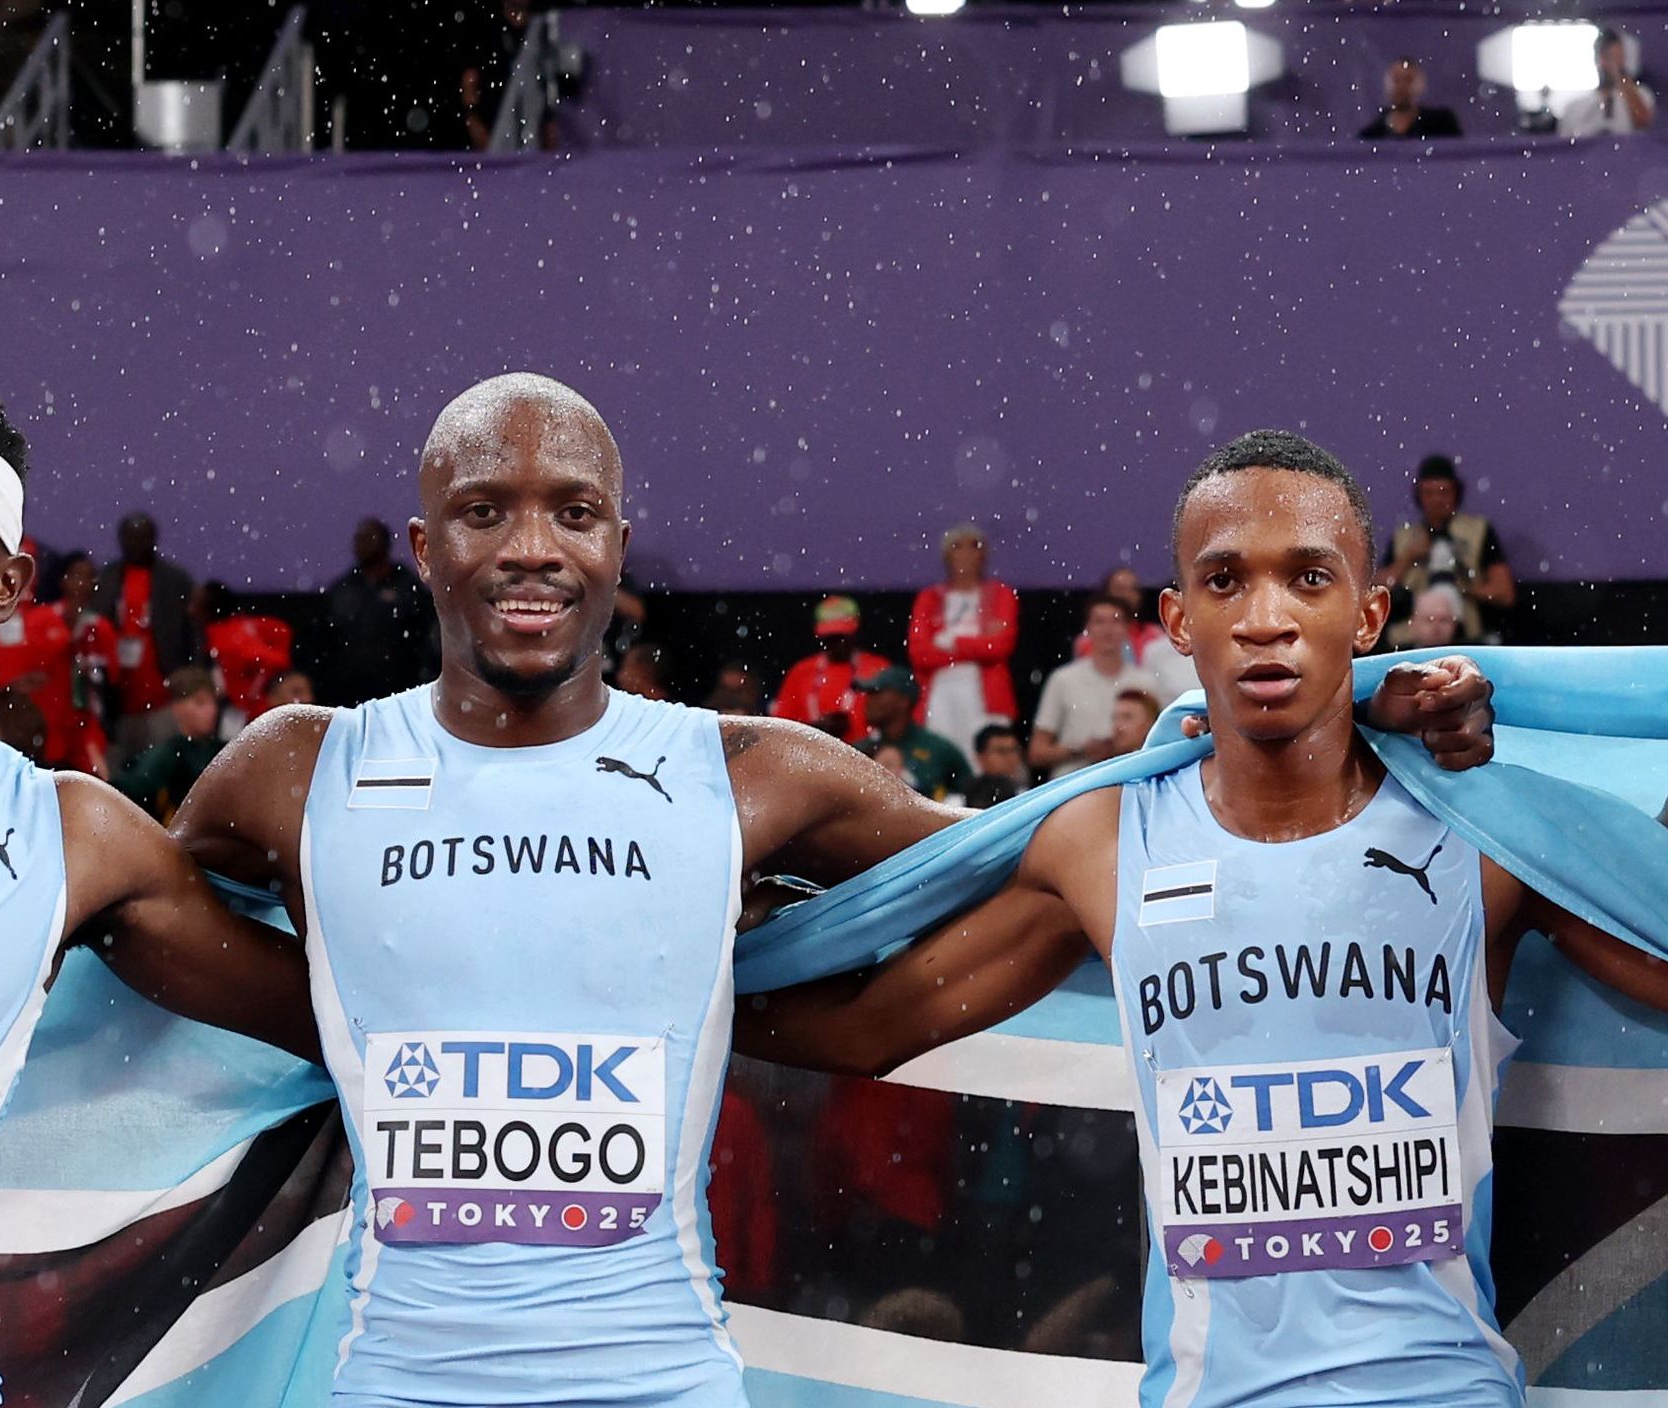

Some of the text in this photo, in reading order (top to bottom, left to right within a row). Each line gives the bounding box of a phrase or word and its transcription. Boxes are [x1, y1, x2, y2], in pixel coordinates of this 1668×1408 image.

[381, 835, 651, 887] BOTSWANA
[1139, 942, 1452, 1035] BOTSWANA
[441, 1041, 641, 1102] TDK
[1230, 1060, 1433, 1132] TDK
[376, 1120, 646, 1185] TEBOGO
[1172, 1137, 1449, 1216] KEBINATSHIPI
